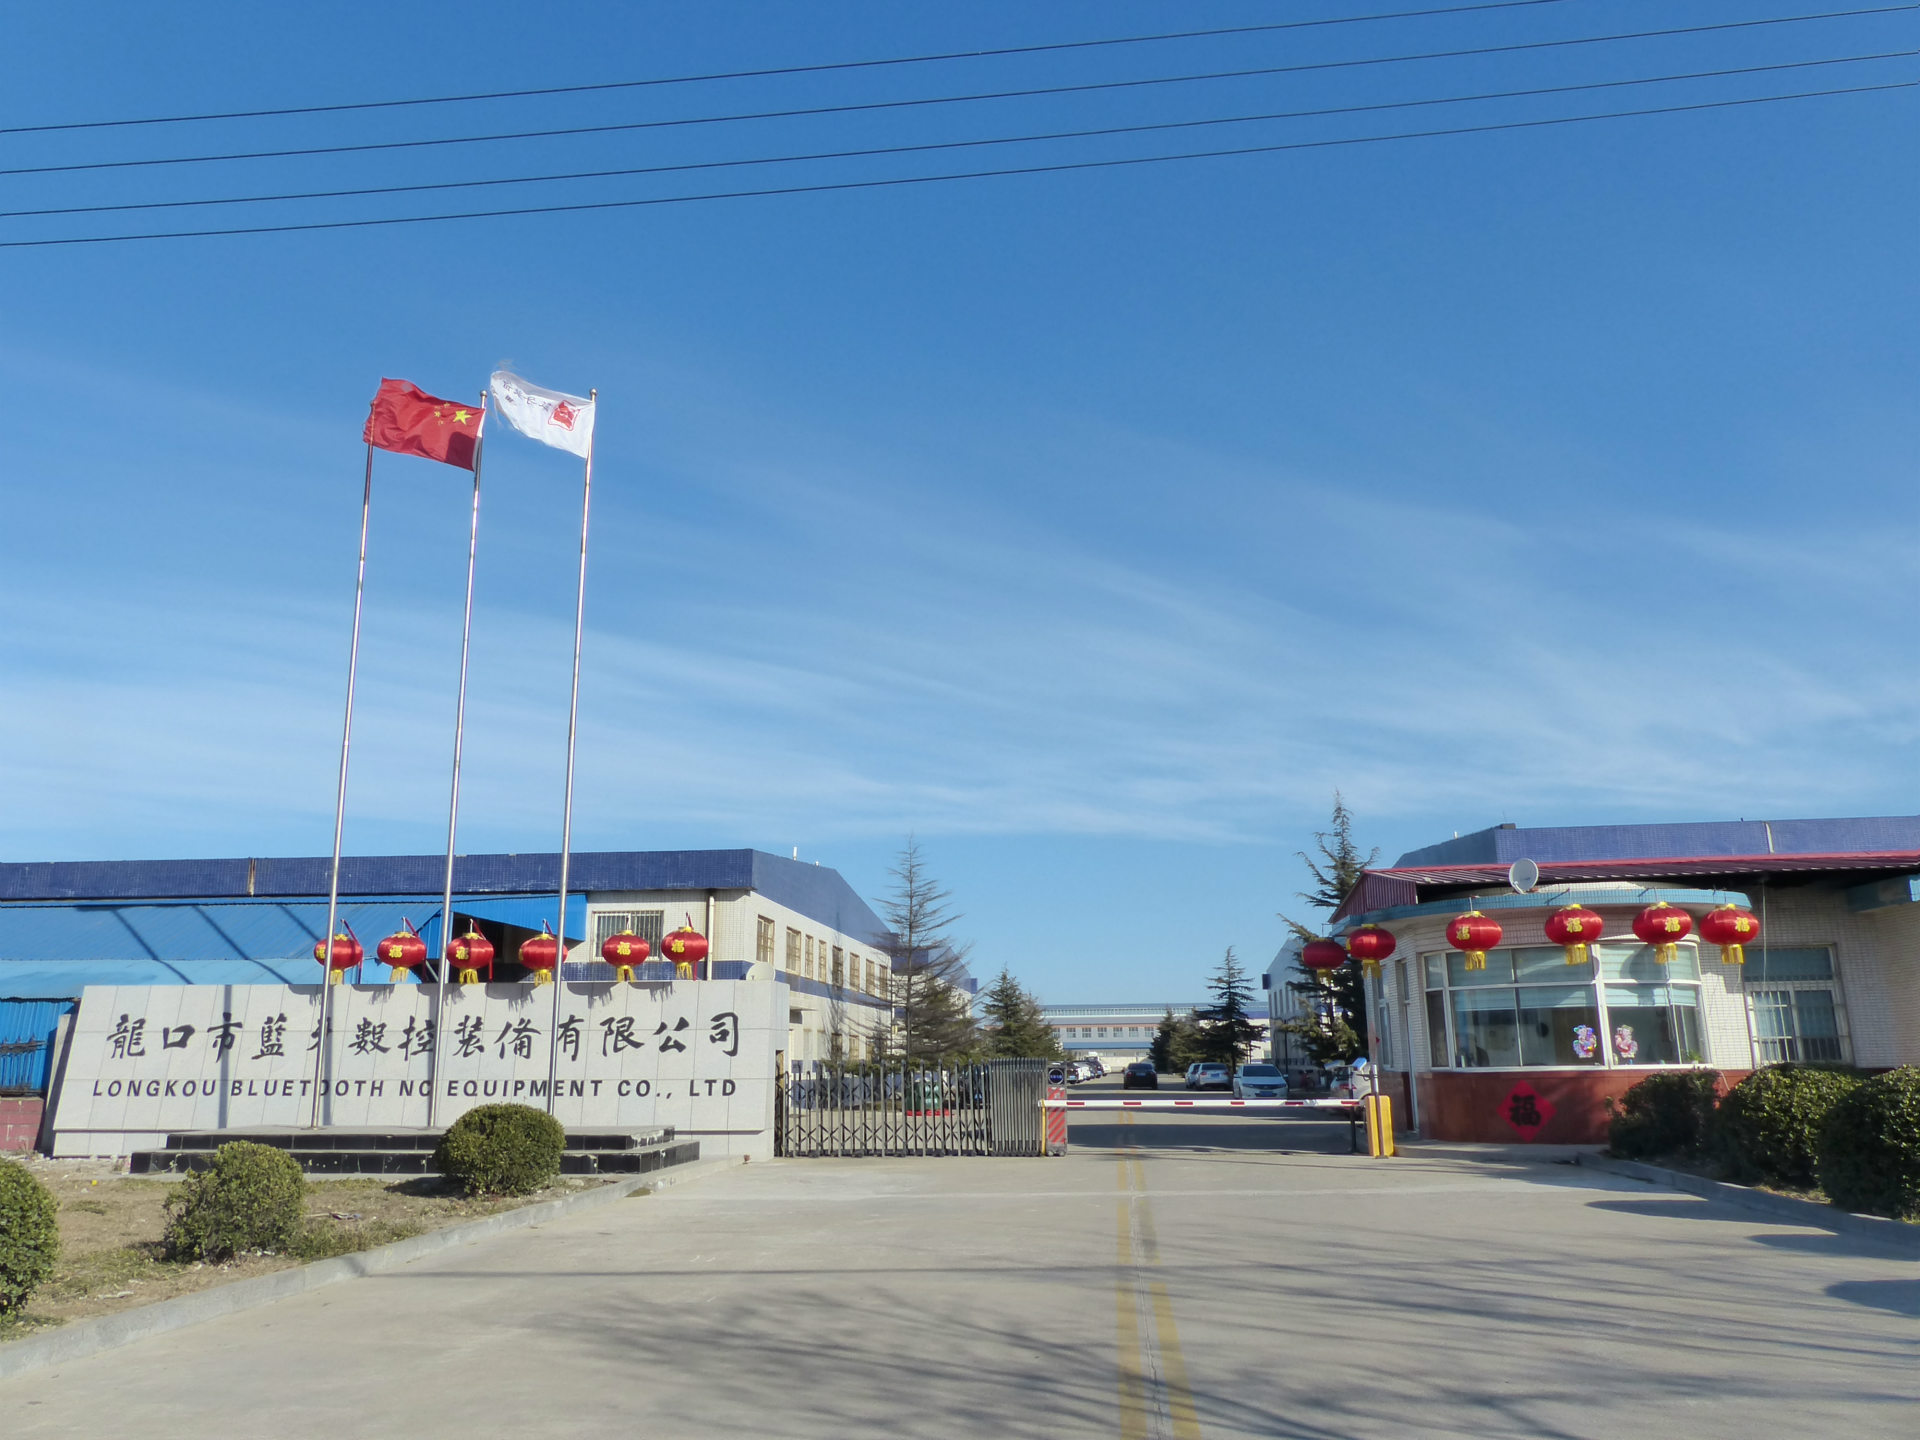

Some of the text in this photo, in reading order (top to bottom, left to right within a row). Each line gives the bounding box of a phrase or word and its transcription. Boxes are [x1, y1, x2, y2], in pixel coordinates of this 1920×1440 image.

[1566, 917, 1583, 933] 福
[1665, 917, 1681, 932] 福
[1735, 917, 1750, 932] 福
[93, 1079, 216, 1097] LONGKOU
[231, 1079, 384, 1097] BLUETOOTH
[399, 1080, 433, 1097] NC
[447, 1080, 603, 1097] EQUIPMENT
[689, 1079, 736, 1097] LTD
